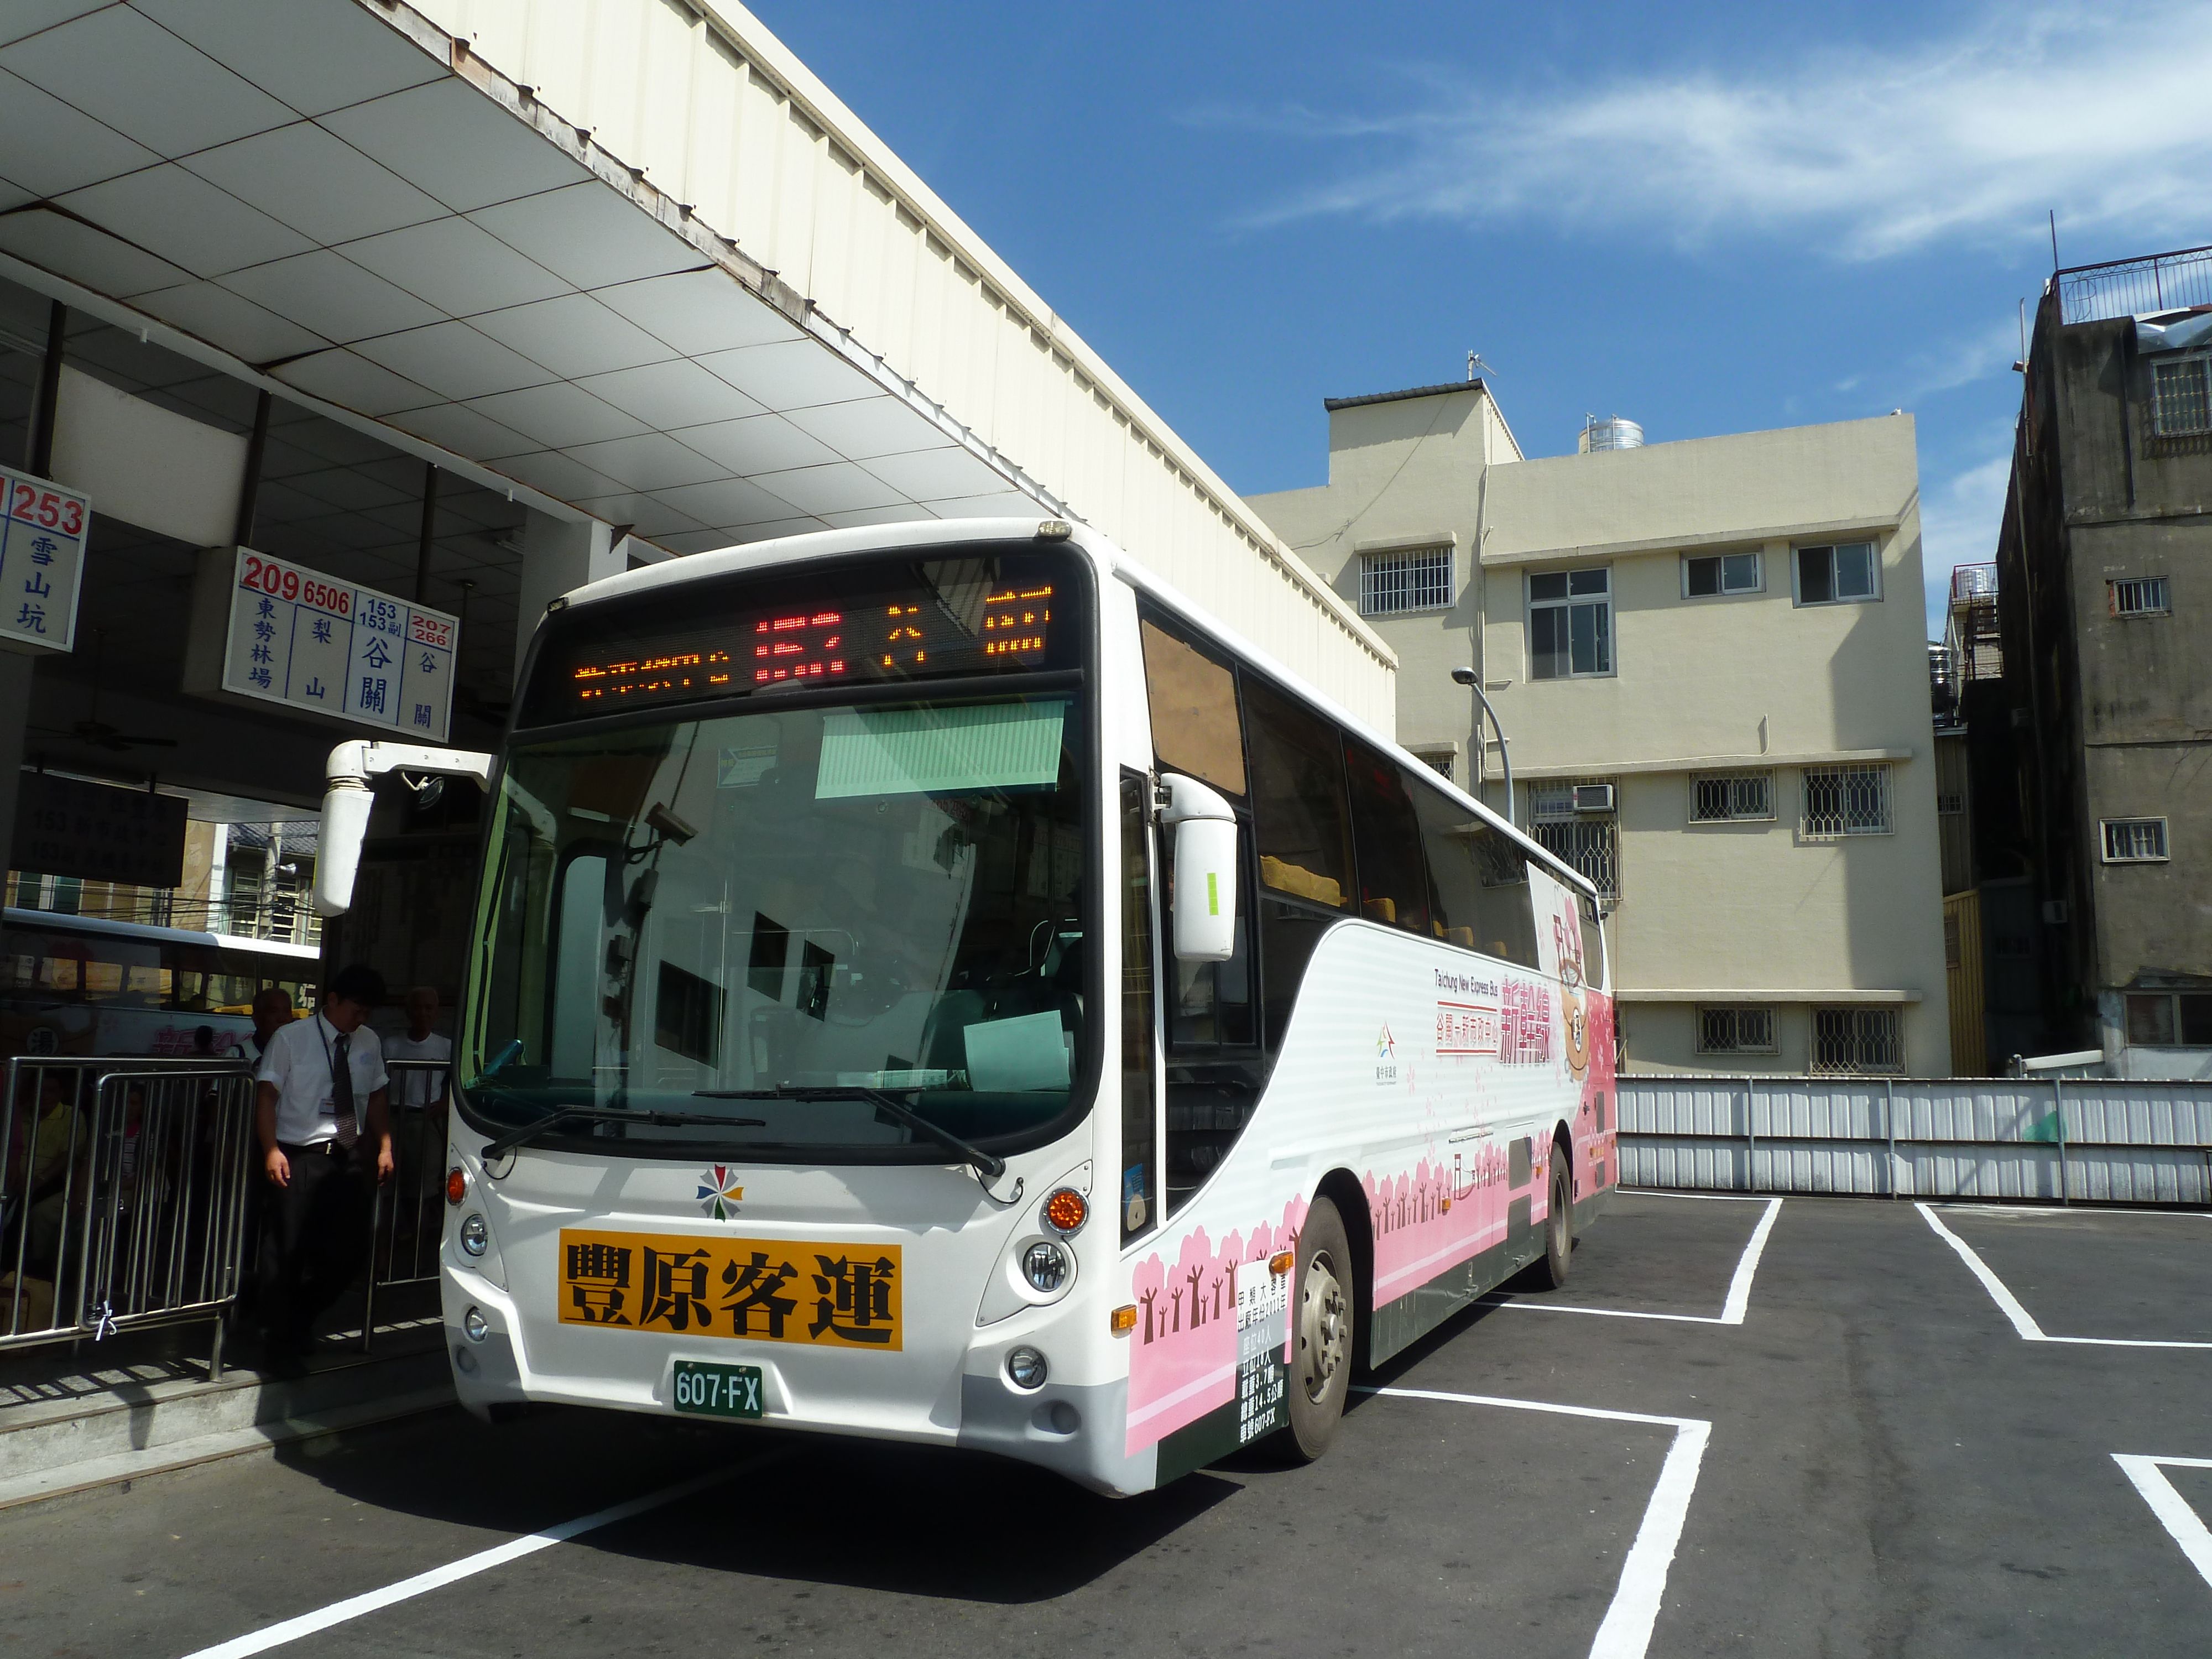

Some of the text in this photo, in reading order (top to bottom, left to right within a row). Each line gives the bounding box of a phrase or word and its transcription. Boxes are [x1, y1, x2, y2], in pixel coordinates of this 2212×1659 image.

[12, 484, 83, 535] 253
[17, 537, 58, 634] 雪山坑
[243, 557, 299, 601] 209
[304, 580, 349, 614] 6506
[368, 599, 396, 619] 153
[412, 615, 451, 633] 207
[248, 598, 276, 689] 東勢林場
[306, 619, 332, 700] 梨山
[415, 629, 447, 646] 266
[360, 637, 393, 714] 谷關
[414, 652, 437, 728] 谷關
[1434, 969, 1498, 997] Taichung New Express Bus
[565, 1243, 895, 1343] 豐原客運
[676, 1371, 759, 1411] 607-FX
